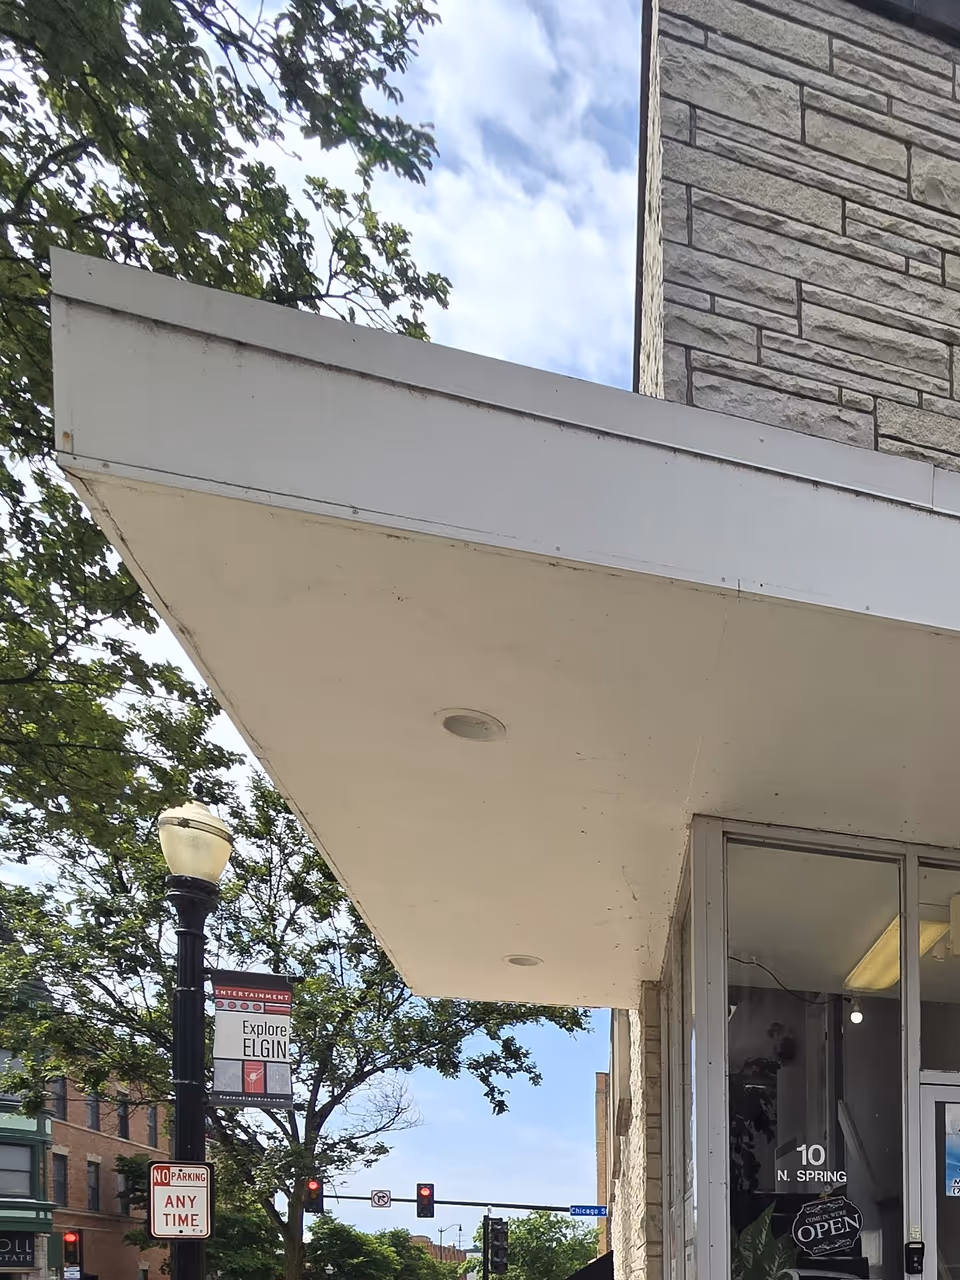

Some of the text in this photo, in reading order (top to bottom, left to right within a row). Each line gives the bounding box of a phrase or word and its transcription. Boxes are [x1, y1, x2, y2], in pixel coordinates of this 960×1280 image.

[215, 989, 289, 1001] ENTERTAINMENT
[242, 1020, 287, 1038] Explore
[243, 1038, 287, 1059] ELGIN
[796, 1144, 825, 1166] 10
[153, 1169, 206, 1183] NO PARKING
[777, 1169, 847, 1183] N. SPRING
[164, 1194, 197, 1209] ANY
[571, 1207, 608, 1216] Chicago S
[162, 1213, 200, 1227] TIME
[797, 1213, 861, 1243] OPEN
